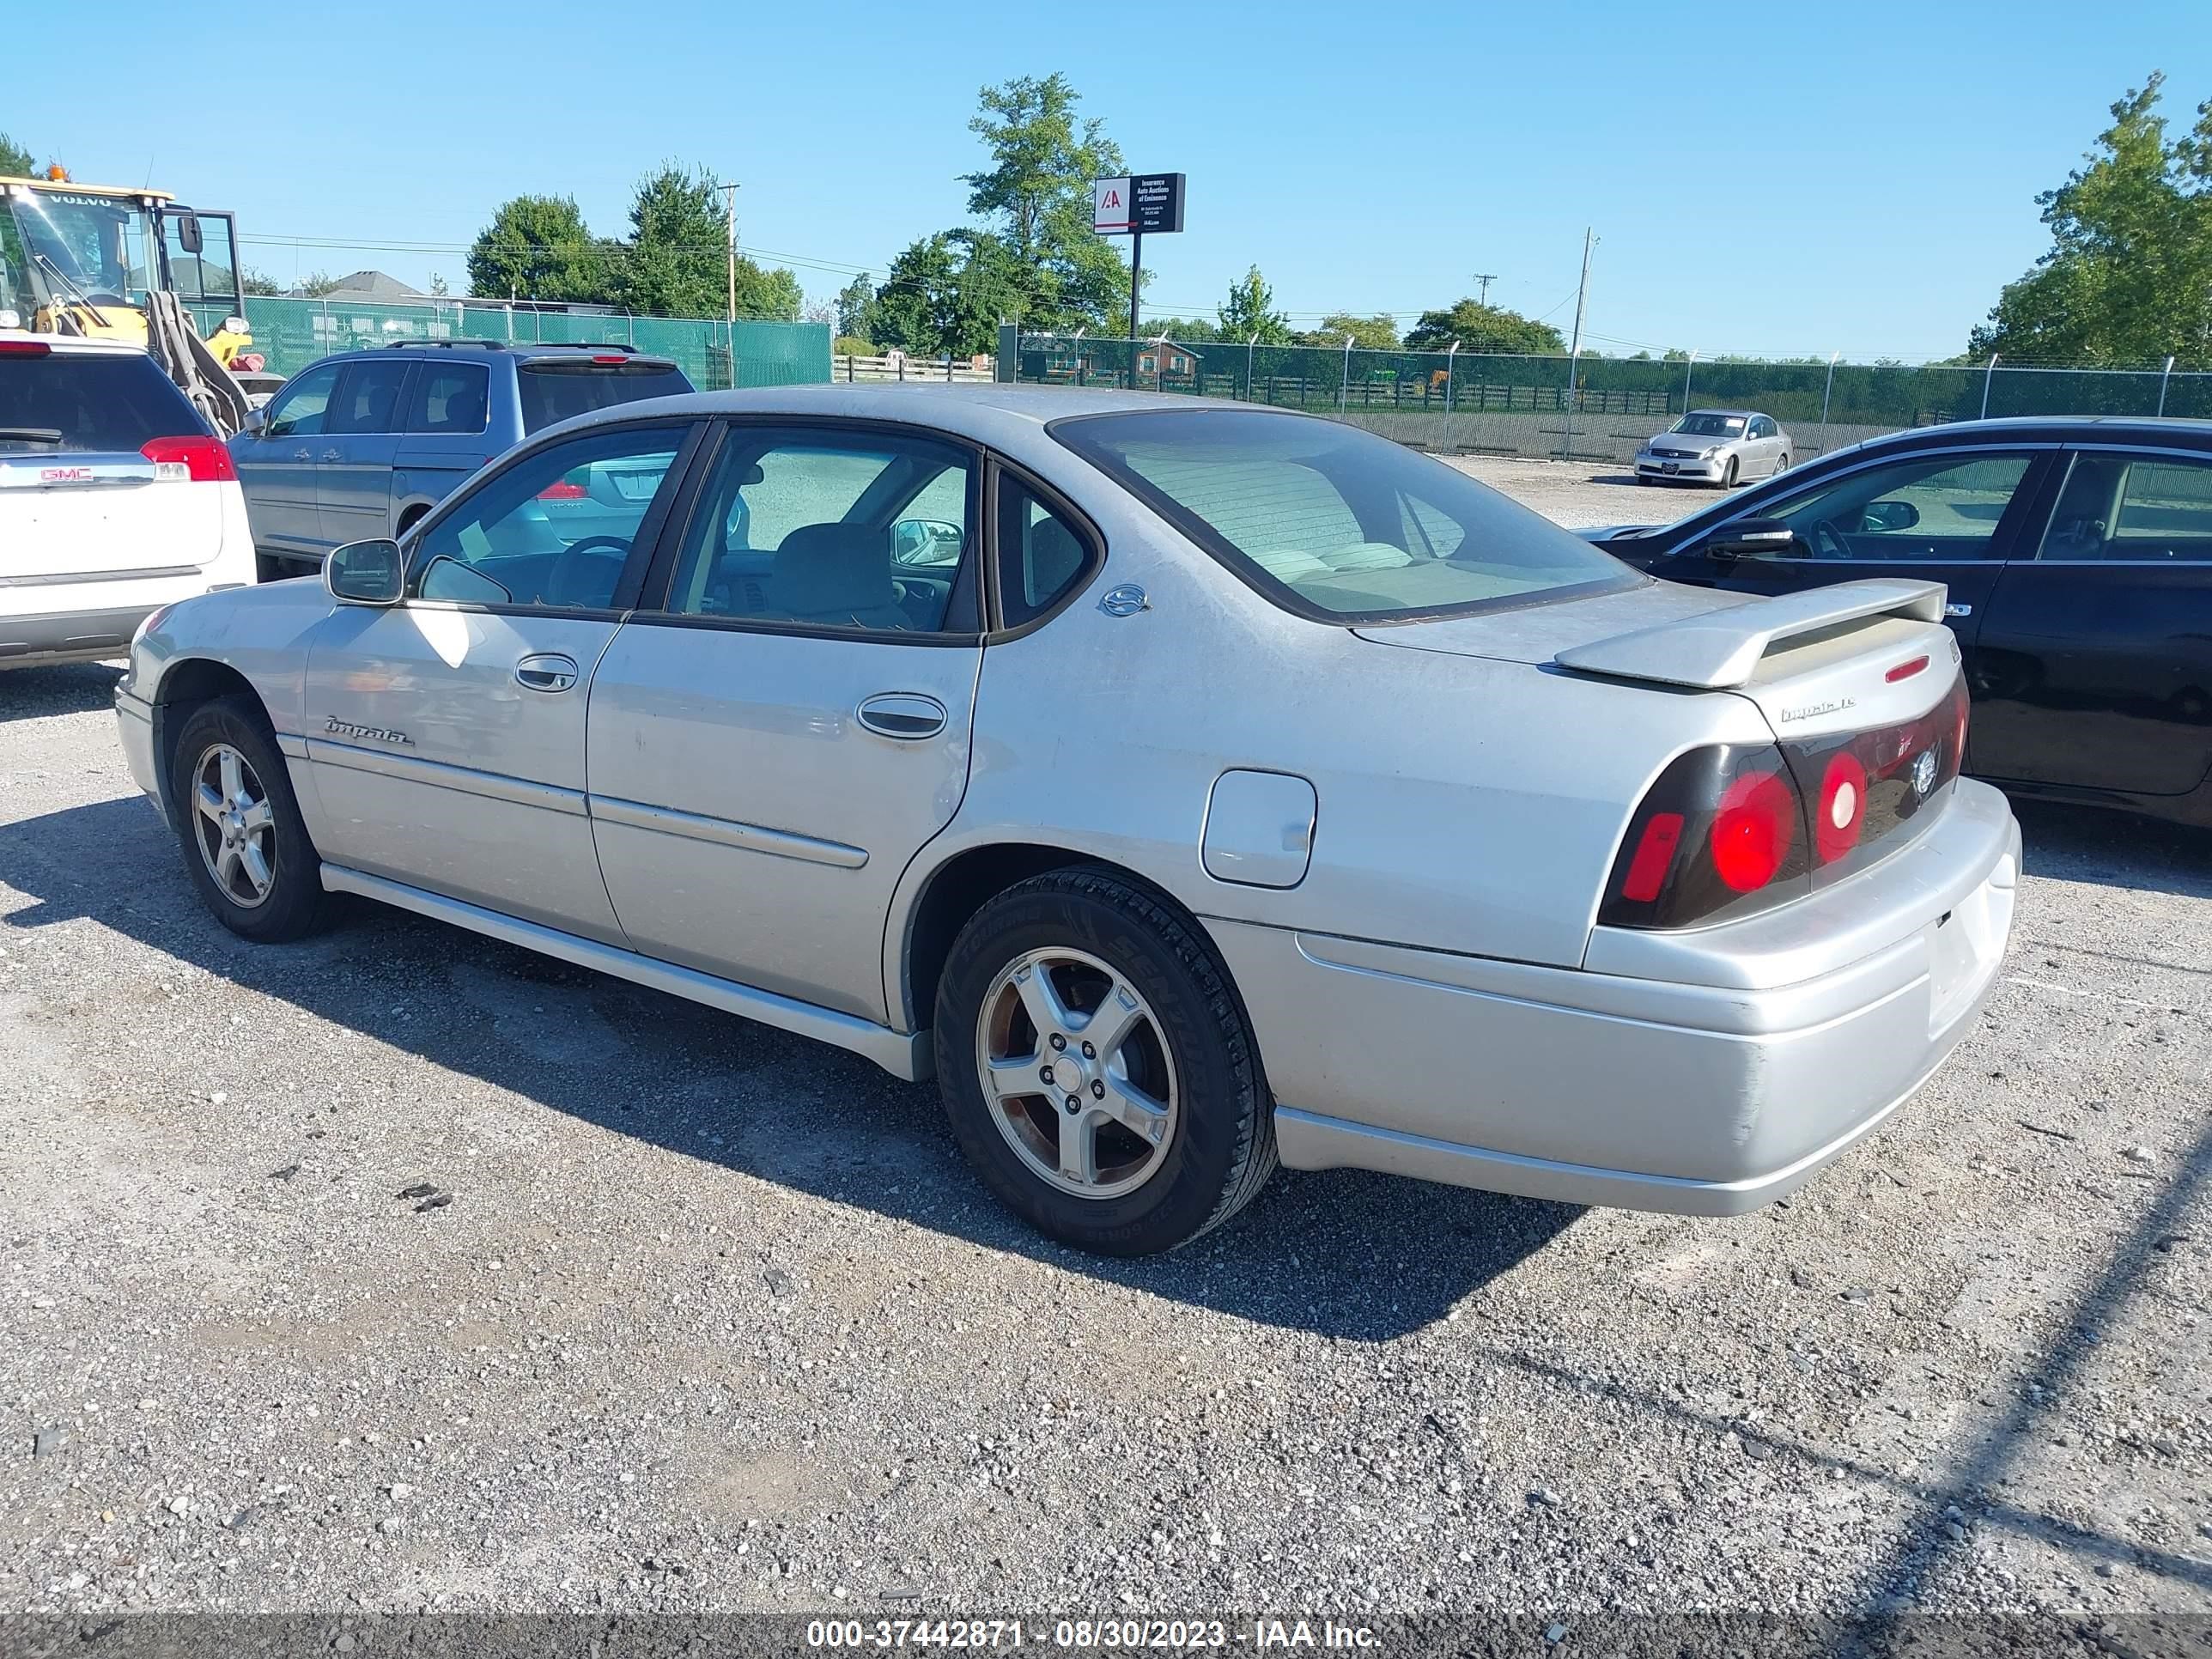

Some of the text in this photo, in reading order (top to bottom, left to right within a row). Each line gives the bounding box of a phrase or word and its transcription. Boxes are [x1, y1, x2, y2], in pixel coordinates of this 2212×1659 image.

[50, 195, 112, 207] VOLVO
[41, 468, 92, 481] GMC
[325, 715, 415, 746] Impala
